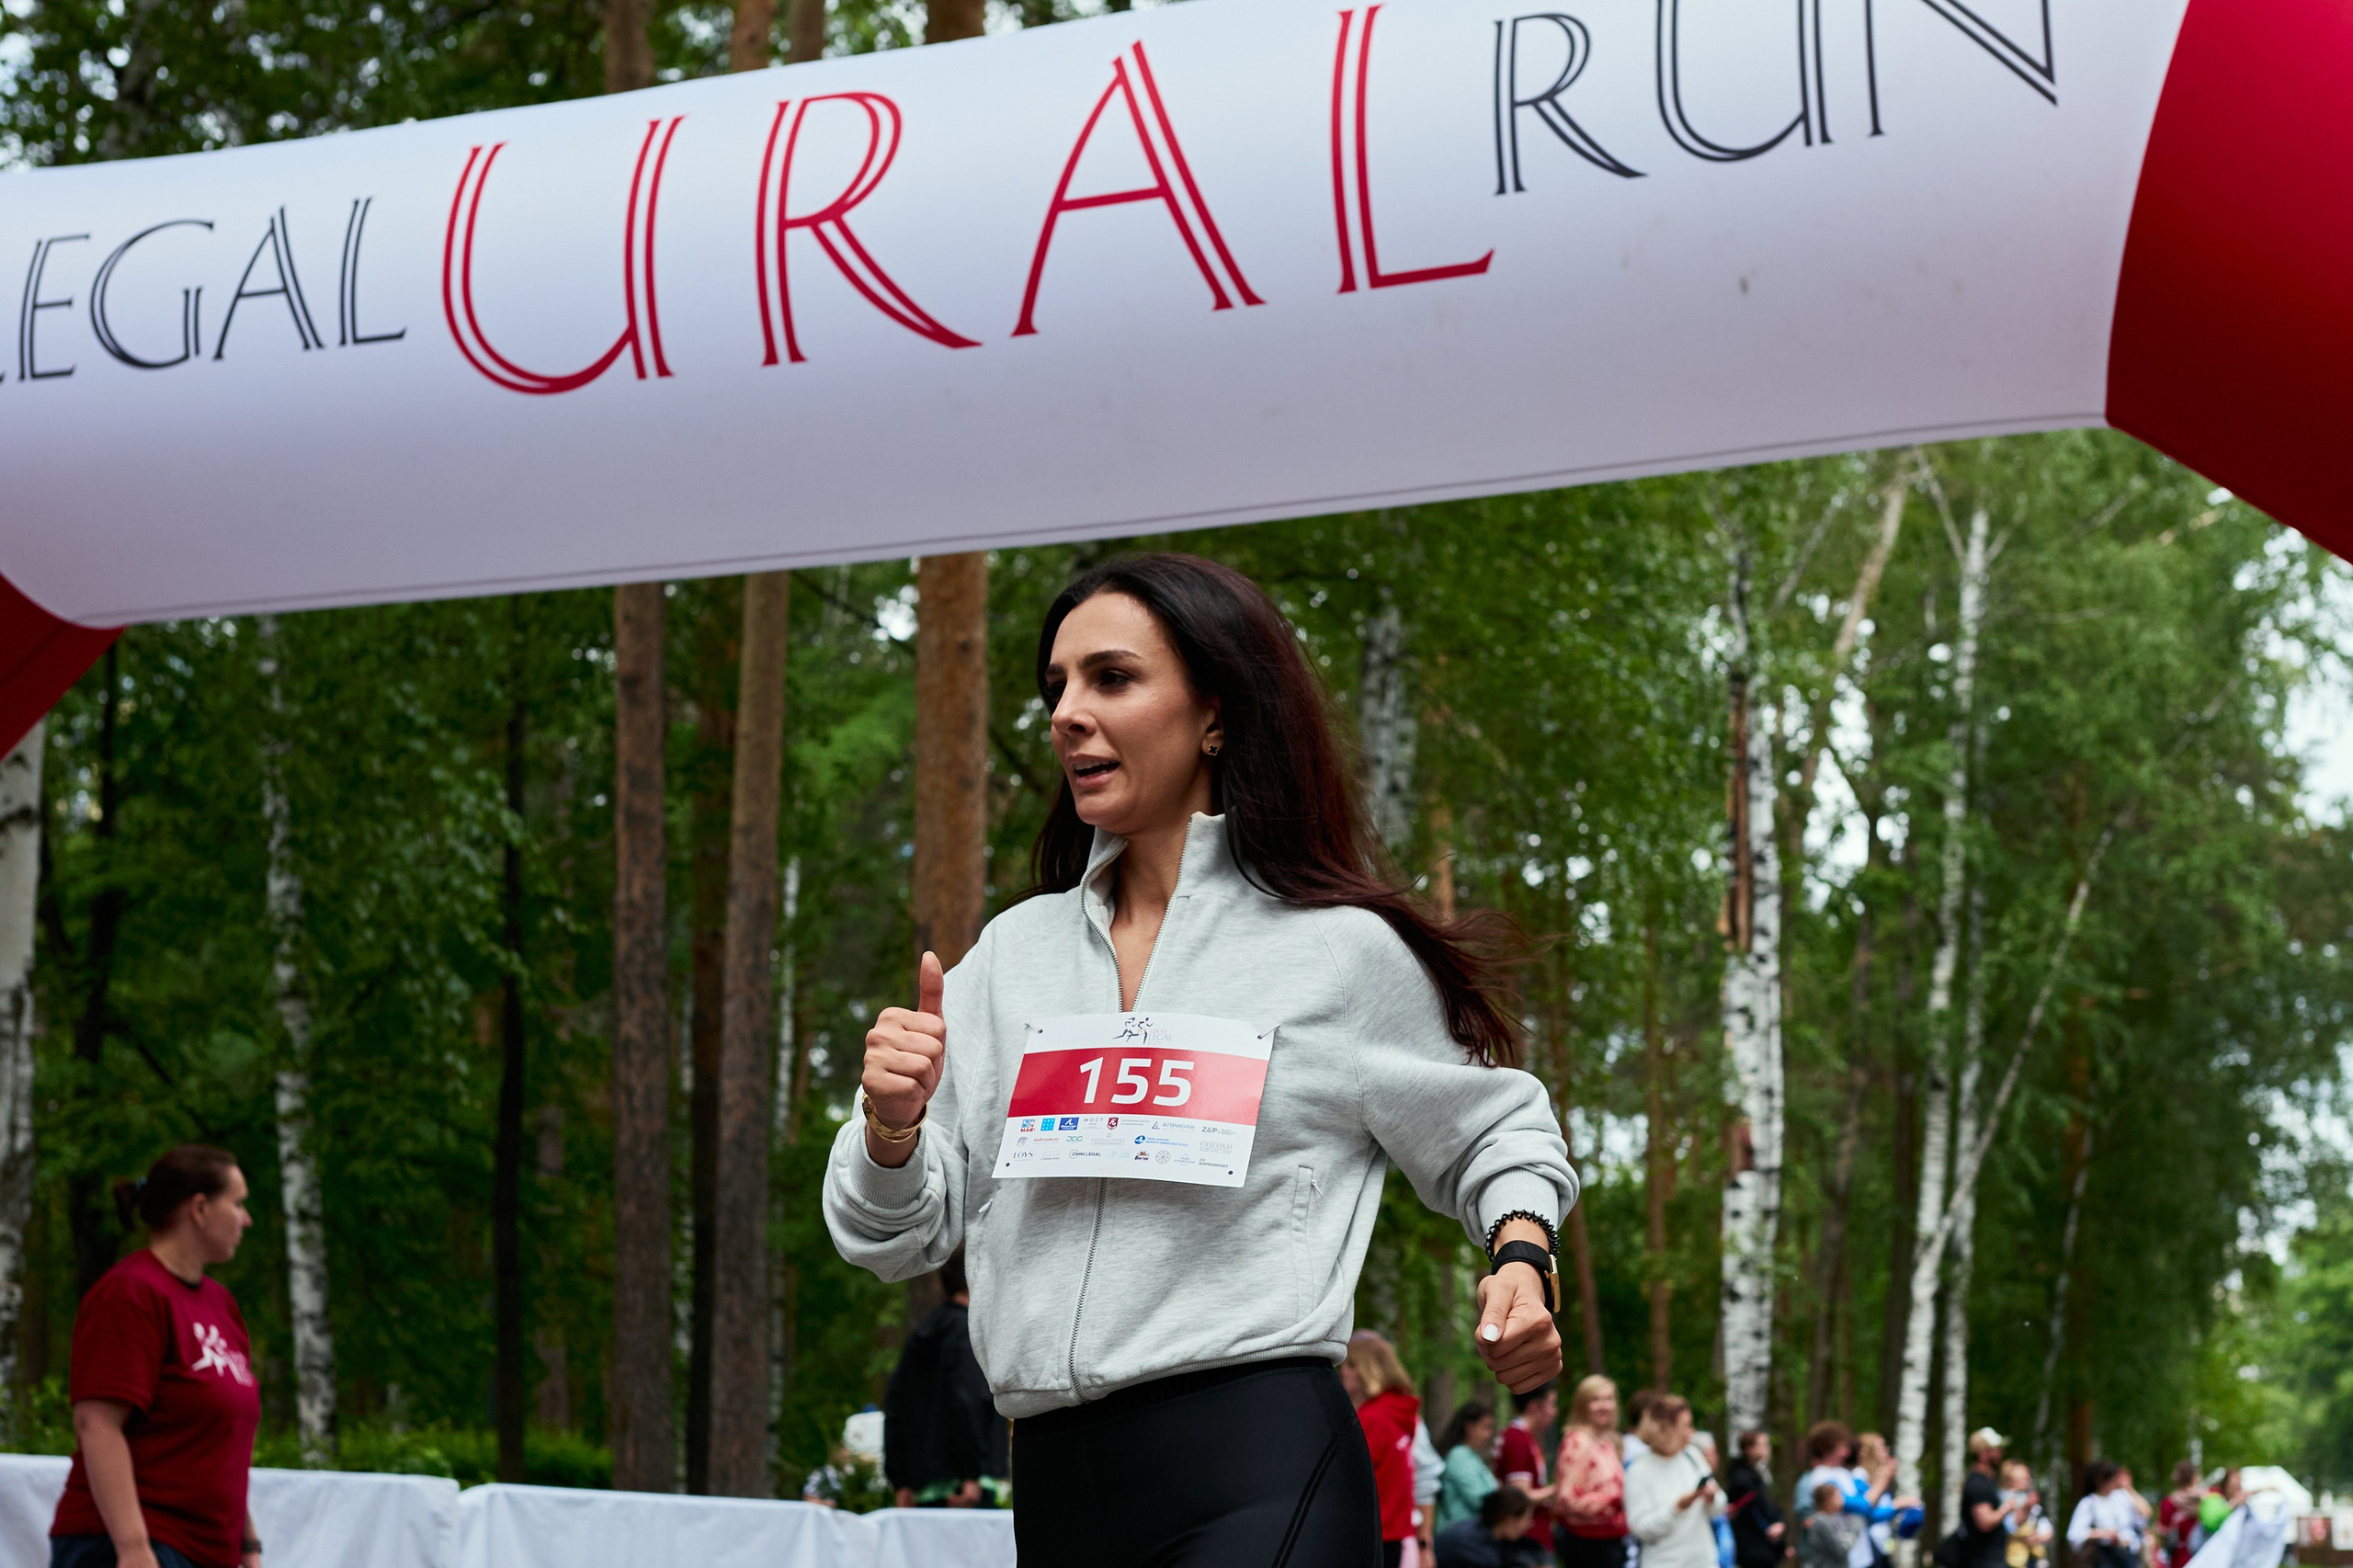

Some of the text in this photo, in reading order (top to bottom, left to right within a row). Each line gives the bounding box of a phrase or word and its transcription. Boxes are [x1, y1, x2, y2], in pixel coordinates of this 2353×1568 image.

[0, 0, 2058, 395] EGAL URAL RUN
[1079, 1056, 1195, 1107] 155
